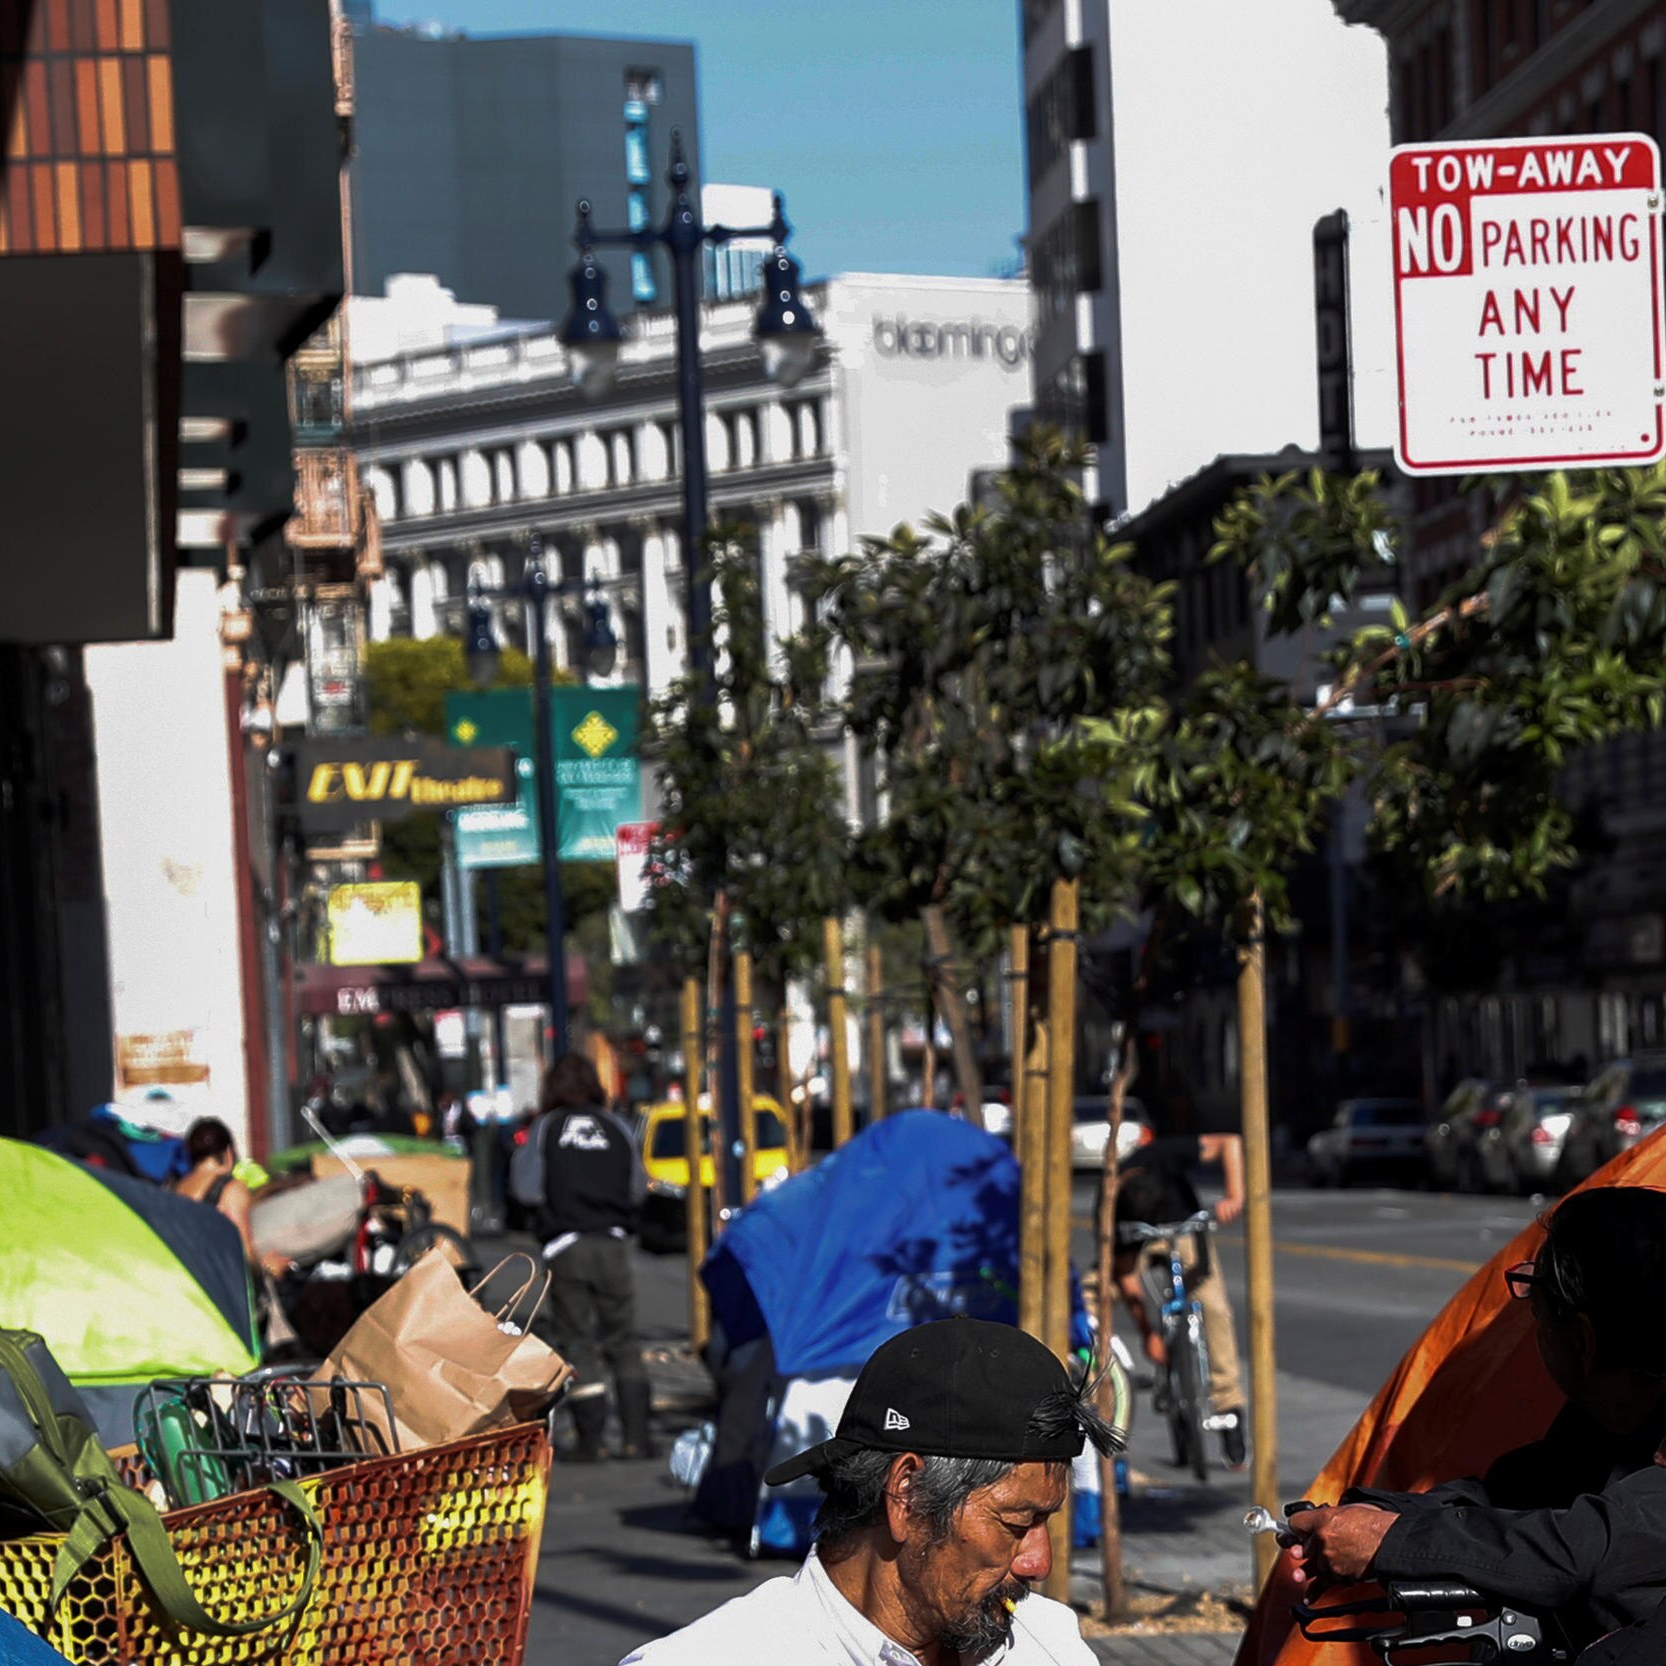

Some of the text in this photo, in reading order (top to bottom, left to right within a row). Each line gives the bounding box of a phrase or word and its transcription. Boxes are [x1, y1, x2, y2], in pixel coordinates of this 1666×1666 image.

[1411, 147, 1632, 193] TOW-AWAY
[1397, 204, 1641, 275] NO PARKING
[1478, 285, 1576, 337] ANY
[1475, 348, 1585, 399] TIME
[306, 759, 420, 804] EXIT
